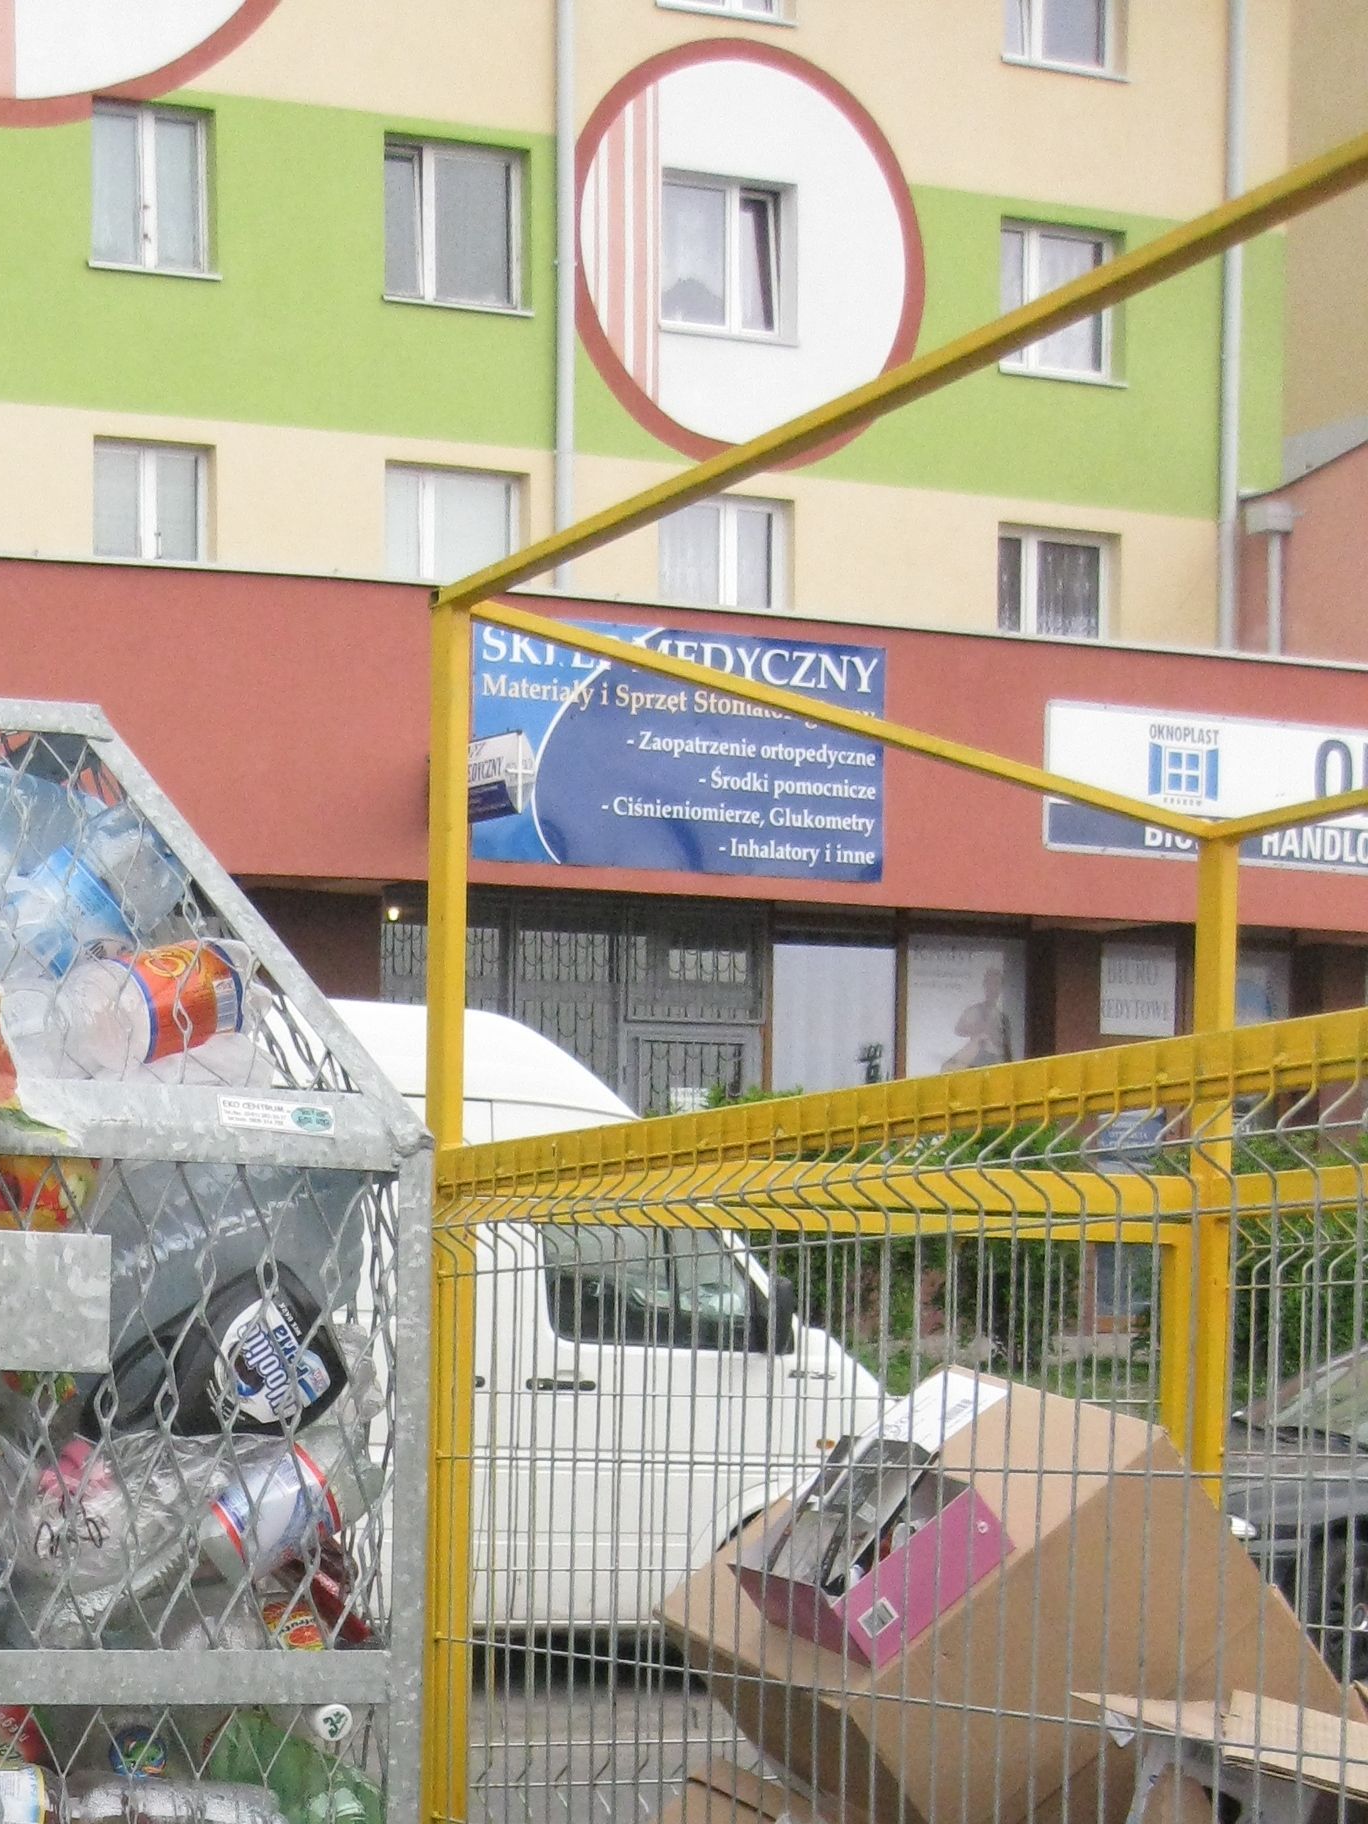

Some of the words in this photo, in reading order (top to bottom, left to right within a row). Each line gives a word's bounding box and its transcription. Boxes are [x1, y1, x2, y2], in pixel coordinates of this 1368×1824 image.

[482, 672, 595, 711] Materiały
[601, 682, 610, 706] i
[615, 683, 688, 716] Sprzęt
[638, 730, 756, 758] Zaopatrzenie
[760, 743, 876, 769] ortopedyczne
[1149, 723, 1220, 746] OKNOPLAST
[711, 766, 769, 793] Środki
[774, 779, 876, 800] pomocnicze
[613, 796, 765, 829] Ciśnieniomierze,
[769, 807, 874, 838] Glukometry
[730, 838, 821, 867] Inhalatory
[825, 844, 831, 863] i
[836, 846, 875, 864] inne
